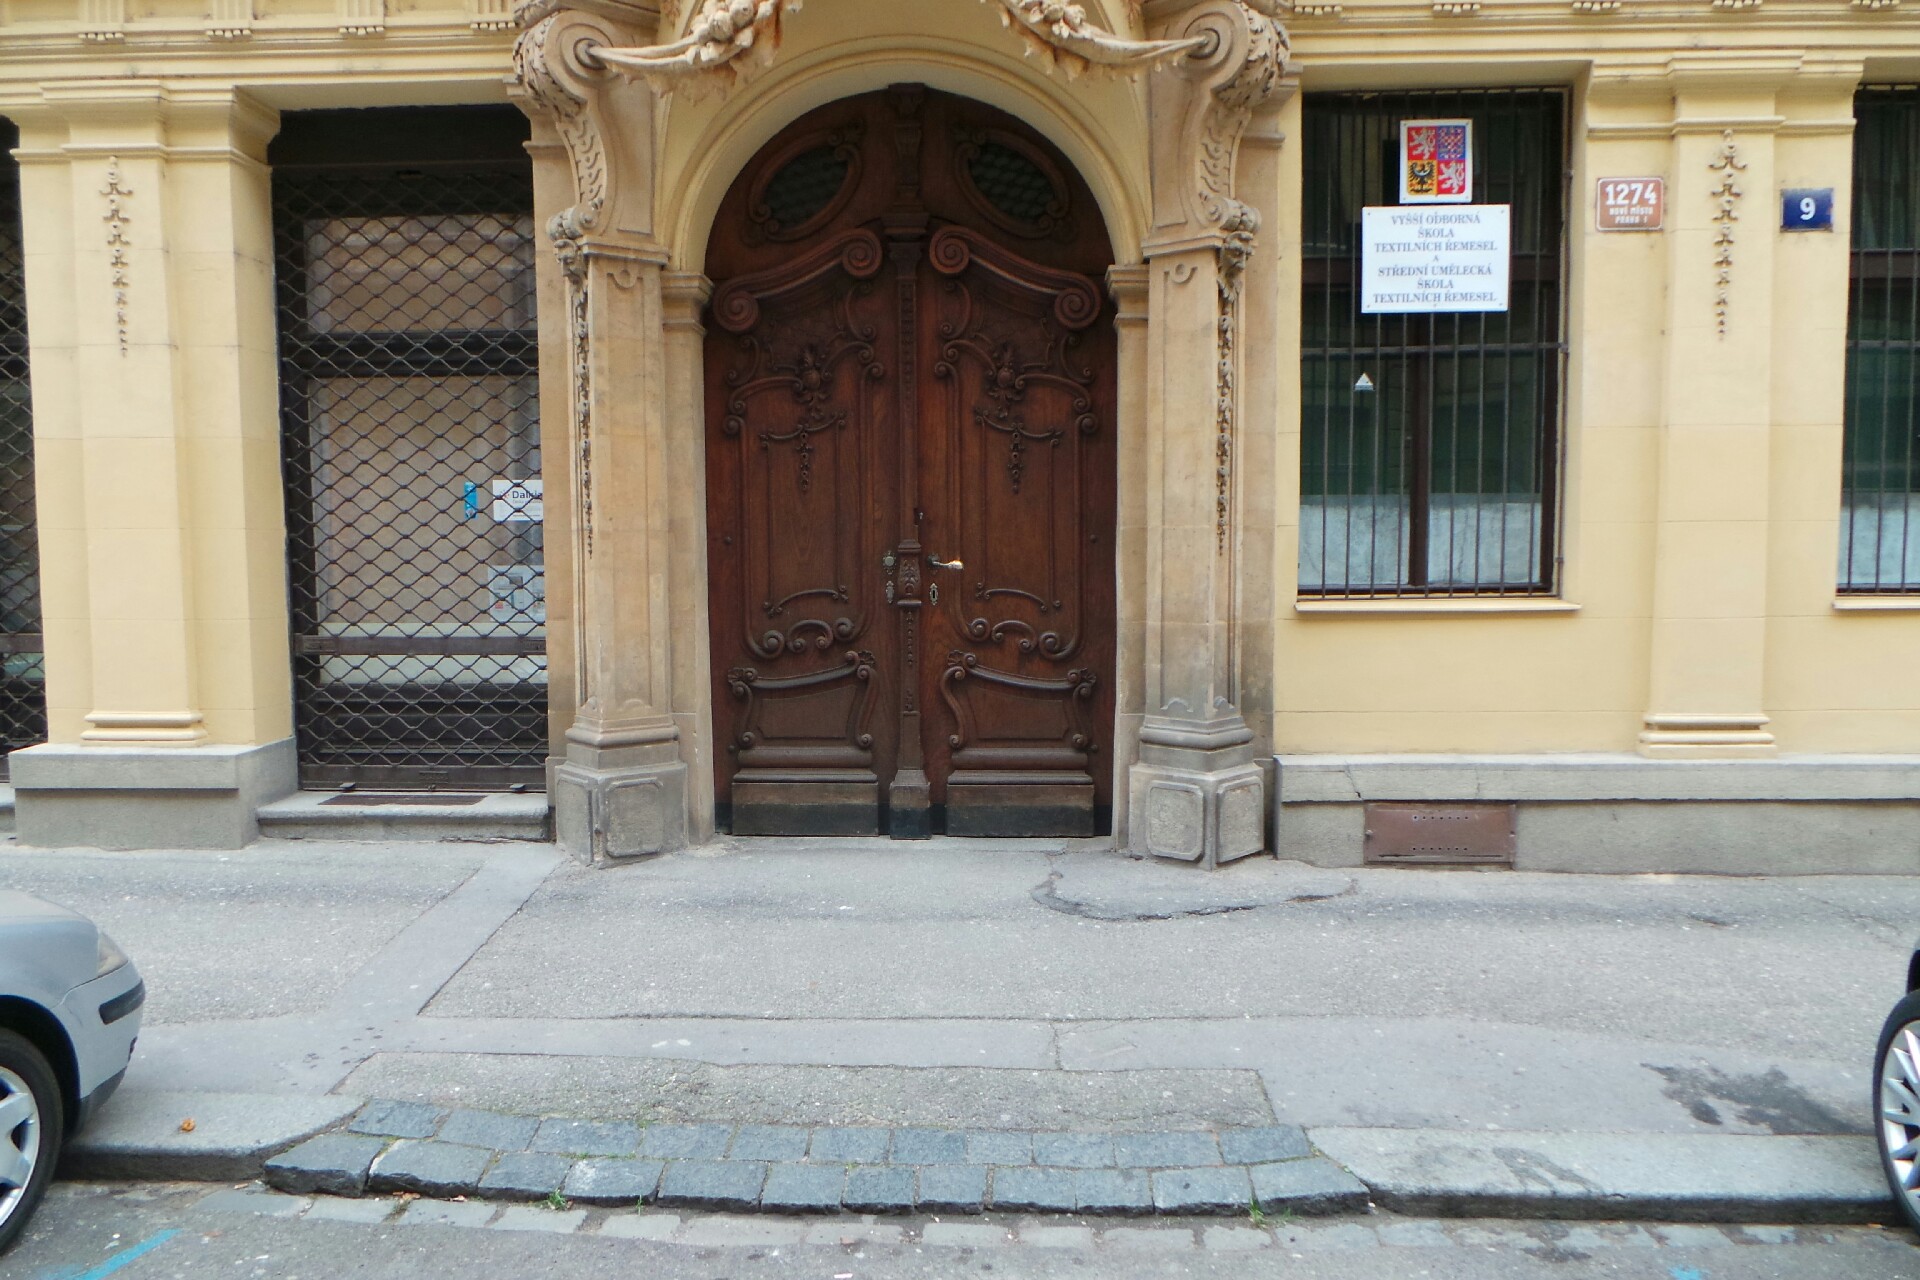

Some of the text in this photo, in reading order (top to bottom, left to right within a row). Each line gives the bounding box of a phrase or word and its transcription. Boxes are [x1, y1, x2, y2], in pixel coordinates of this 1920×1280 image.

[1605, 183, 1657, 205] 1274
[1800, 197, 1816, 220] 9
[1391, 212, 1480, 225] VYŠŠÍ ODBORNÁ
[1418, 228, 1454, 238] ŠKOLA
[1374, 240, 1498, 253] TEXTILNÍCH ŘEMESEL
[1378, 263, 1492, 277] STŘEDNÍ UMĚLECKÁ
[1417, 278, 1454, 289] ŠKOLA
[1373, 291, 1497, 304] TEXTILNÍCH ŘEMESEL
